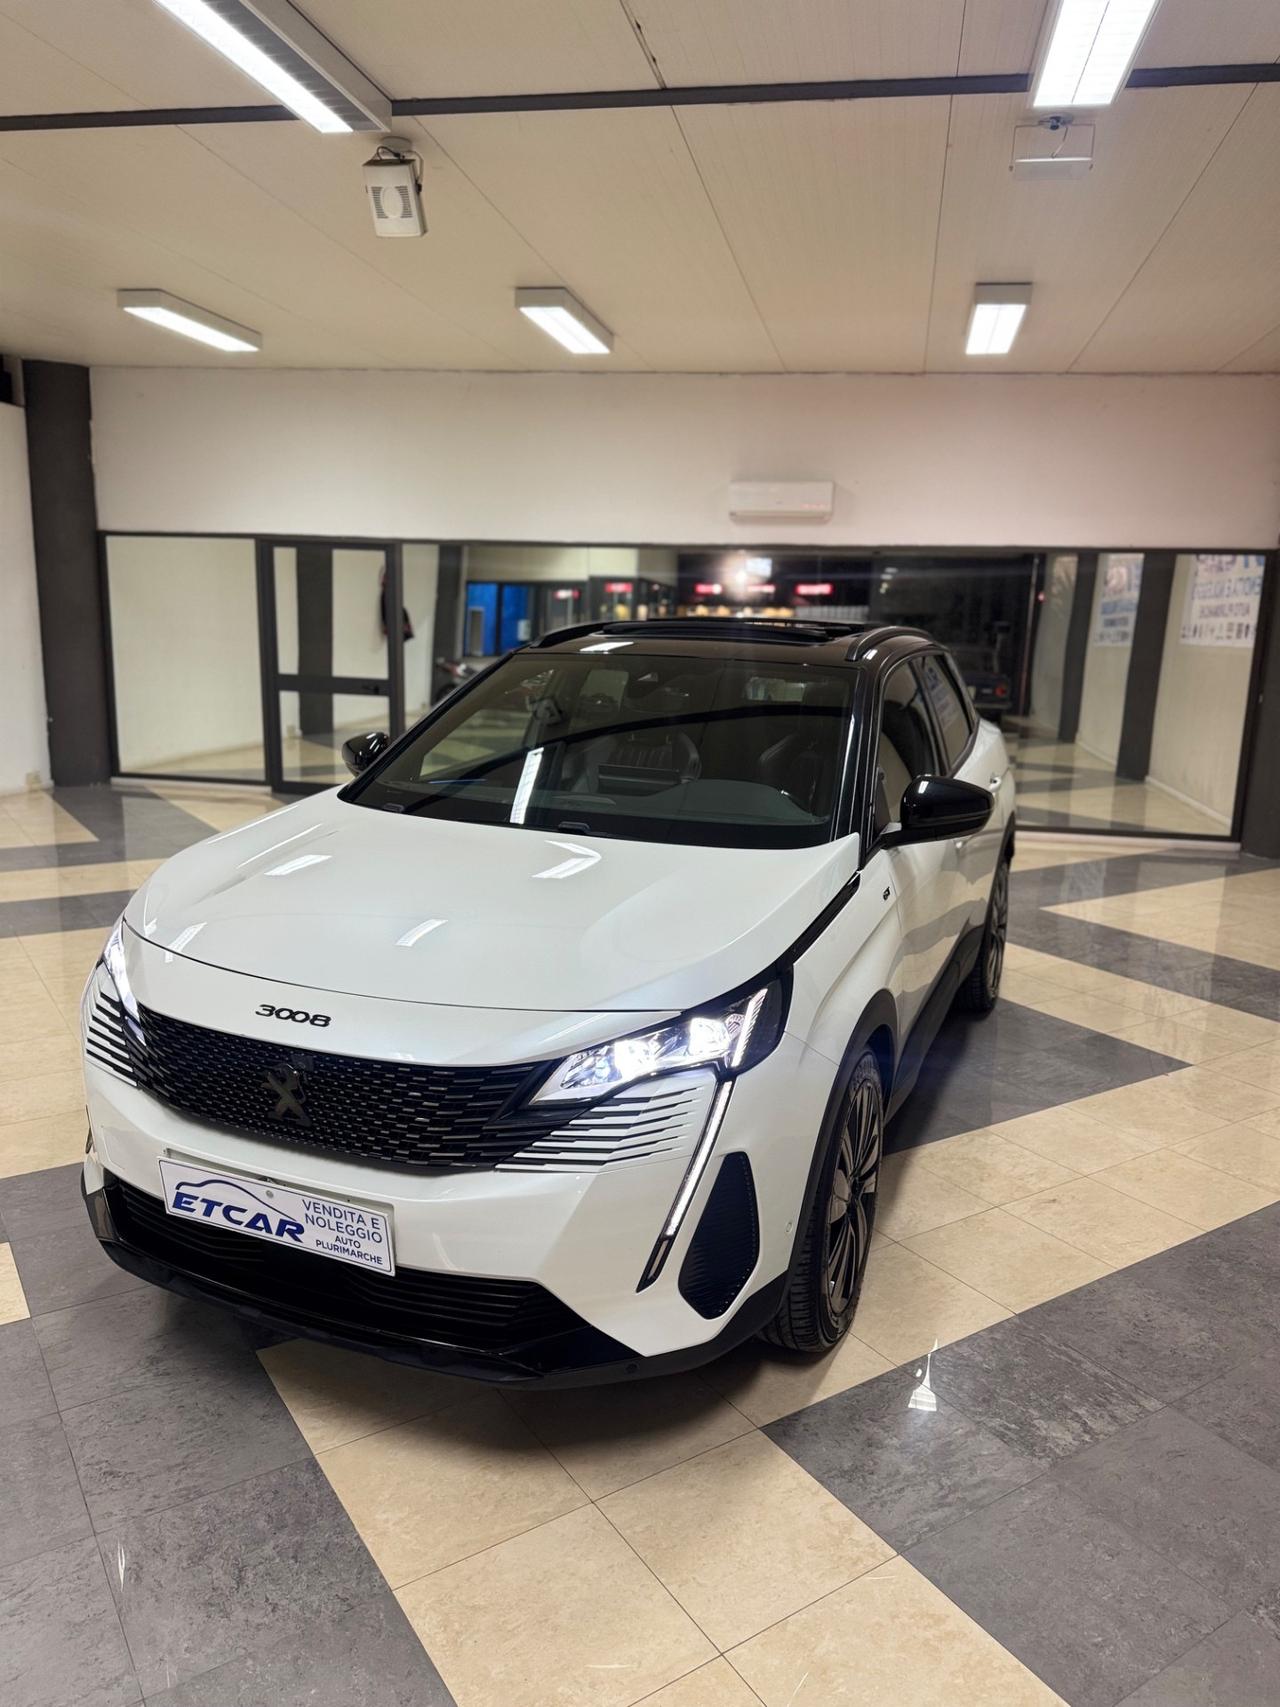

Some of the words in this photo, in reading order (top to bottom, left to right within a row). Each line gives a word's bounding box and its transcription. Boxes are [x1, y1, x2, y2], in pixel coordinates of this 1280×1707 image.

[255, 1004, 331, 1027] 3008
[172, 1191, 305, 1243] ETCAR
[302, 1199, 366, 1226] VENDITA
[371, 1215, 380, 1230] E
[305, 1213, 382, 1244] NOLEGGIO
[316, 1239, 382, 1265] PLURIMARCHE
[335, 1236, 361, 1249] AUTO
